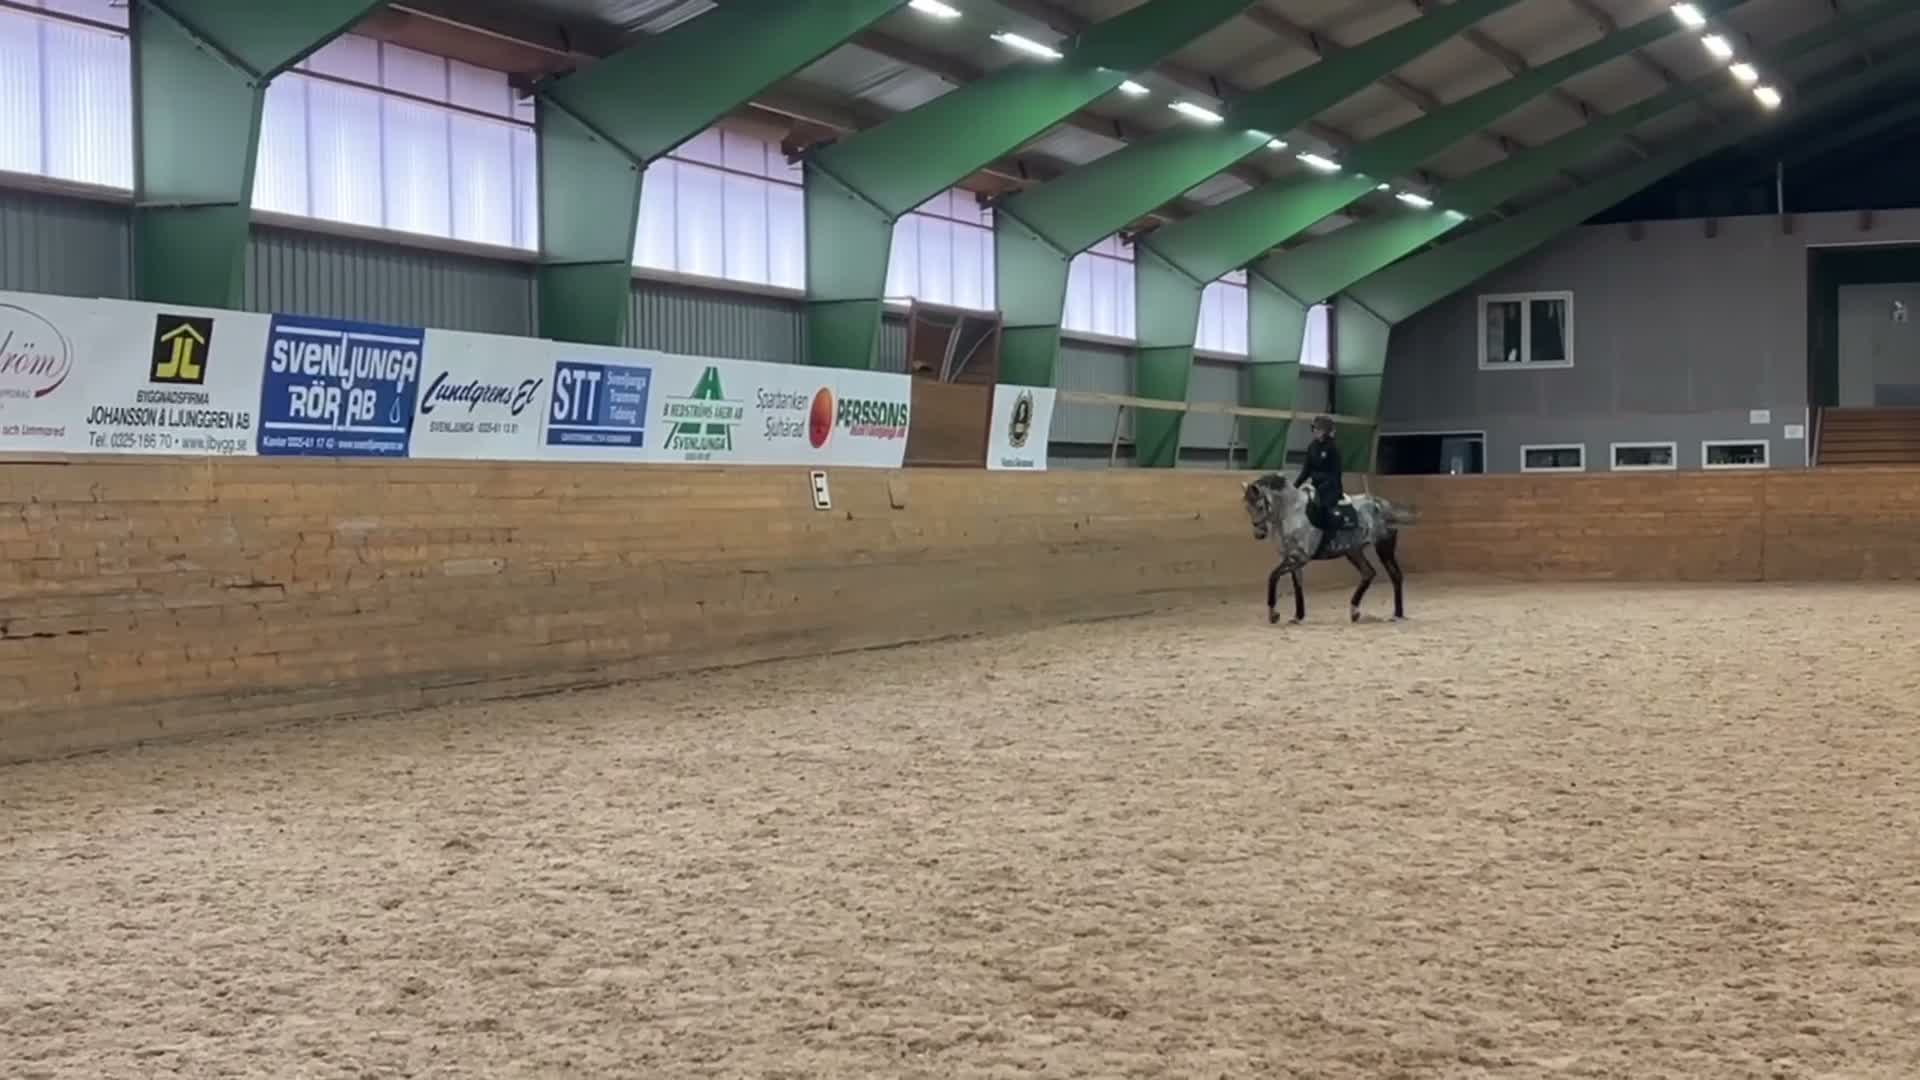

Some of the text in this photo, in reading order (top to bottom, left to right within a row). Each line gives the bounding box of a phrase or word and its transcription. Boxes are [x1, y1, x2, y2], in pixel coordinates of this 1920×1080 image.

[136, 389, 209, 404] BYGGNADSFIRMA
[288, 380, 377, 431] RÖR AB
[421, 371, 544, 416] Lundgrens El
[553, 367, 601, 421] STT
[756, 387, 809, 414] Sparbanken
[86, 405, 251, 430] JOHANSSON & LJUNGGREN AB
[836, 397, 909, 428] PERSSONS
[89, 431, 107, 448] Tel.
[764, 415, 806, 441] Sjuhärad
[672, 435, 726, 451] SVENLJUNGA
[813, 473, 829, 507] E
